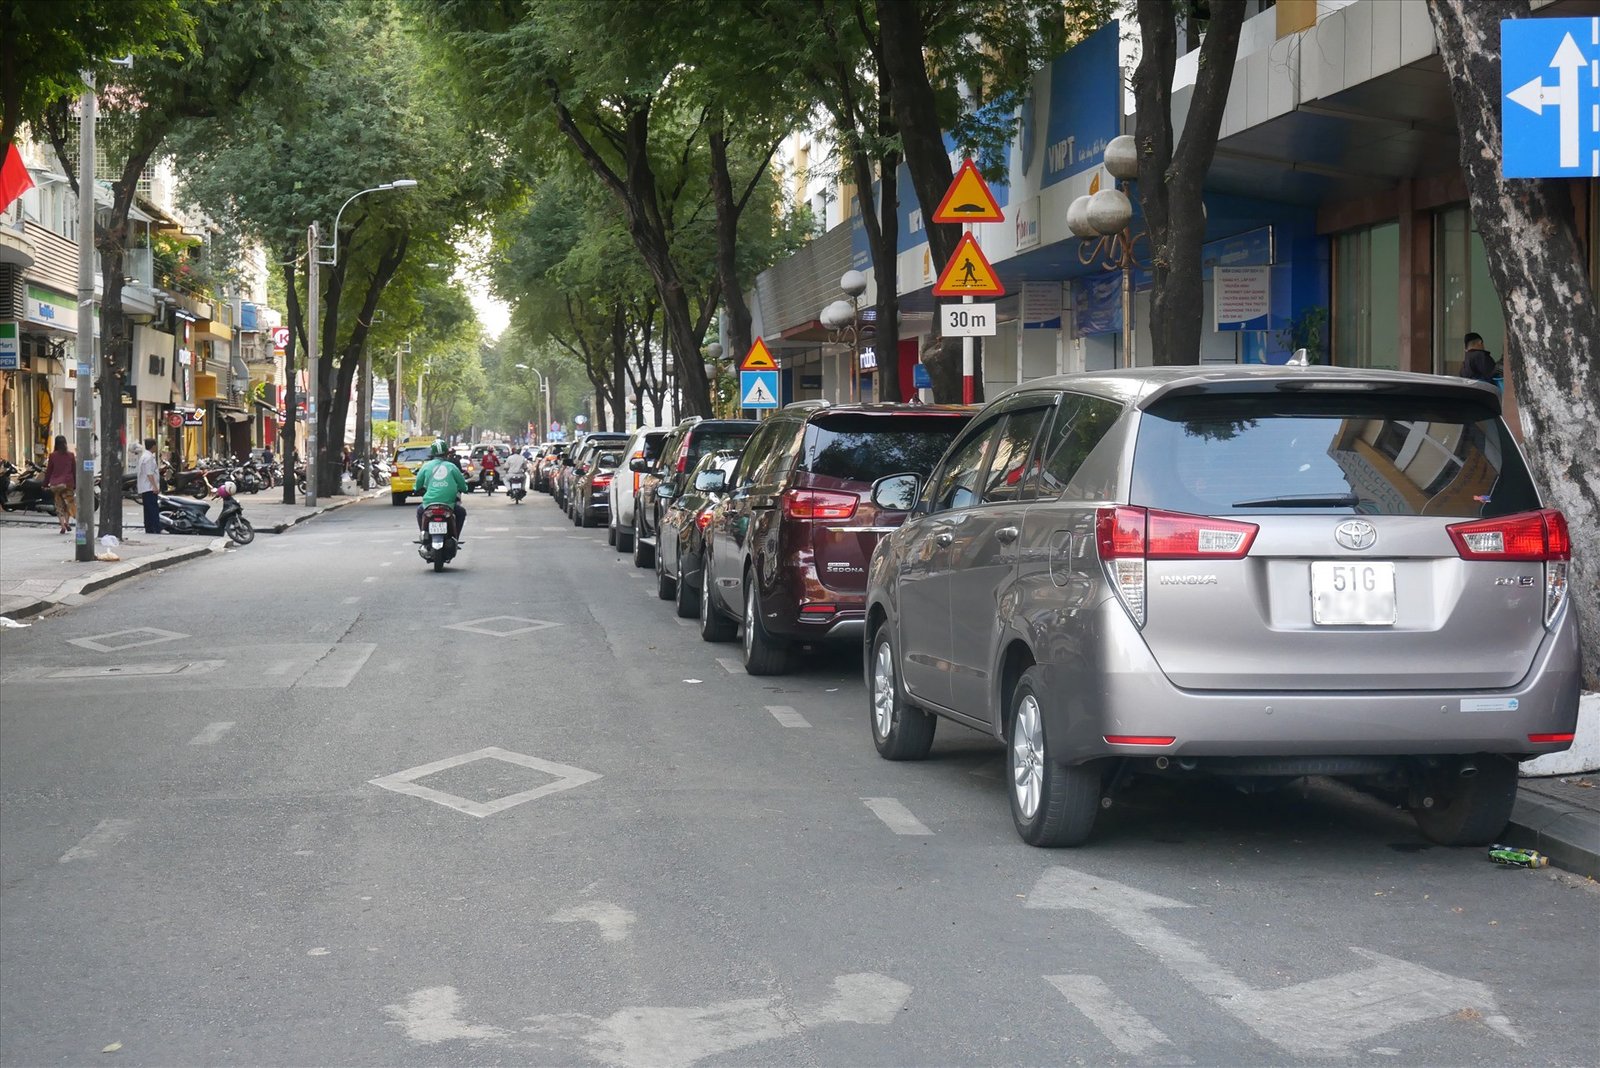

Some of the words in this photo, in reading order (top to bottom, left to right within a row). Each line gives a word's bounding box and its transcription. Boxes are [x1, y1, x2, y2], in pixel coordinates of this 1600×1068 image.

[1048, 136, 1075, 174] VNPT
[950, 311, 968, 327] 30
[971, 315, 986, 327] m
[1160, 575, 1218, 585] INNOVA
[1333, 566, 1375, 591] 51G
